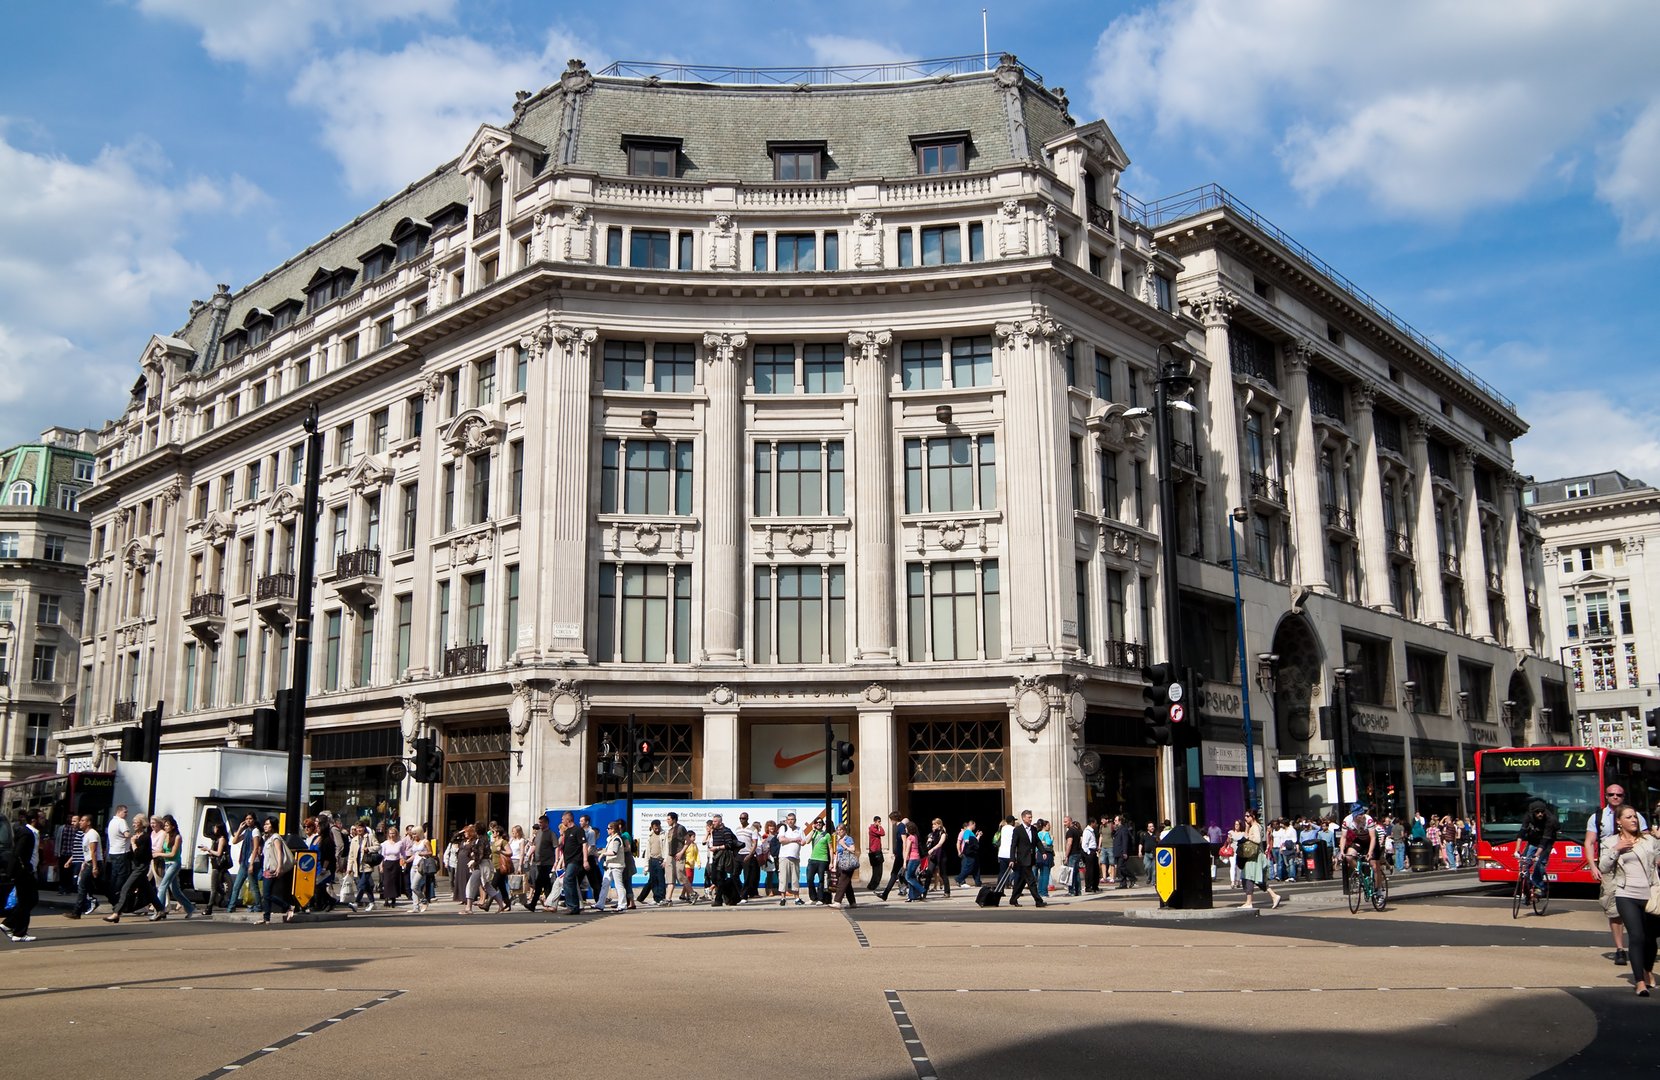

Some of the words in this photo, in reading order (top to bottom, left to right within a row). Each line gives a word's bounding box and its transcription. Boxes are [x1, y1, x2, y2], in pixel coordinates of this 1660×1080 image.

[749, 687, 849, 698] NIKETOWN
[1357, 712, 1389, 731] TOPSHOP
[1472, 727, 1498, 742] TOPMAN
[1502, 757, 1541, 767] Victoria
[1563, 753, 1587, 768] 73
[83, 777, 112, 786] Dulwich
